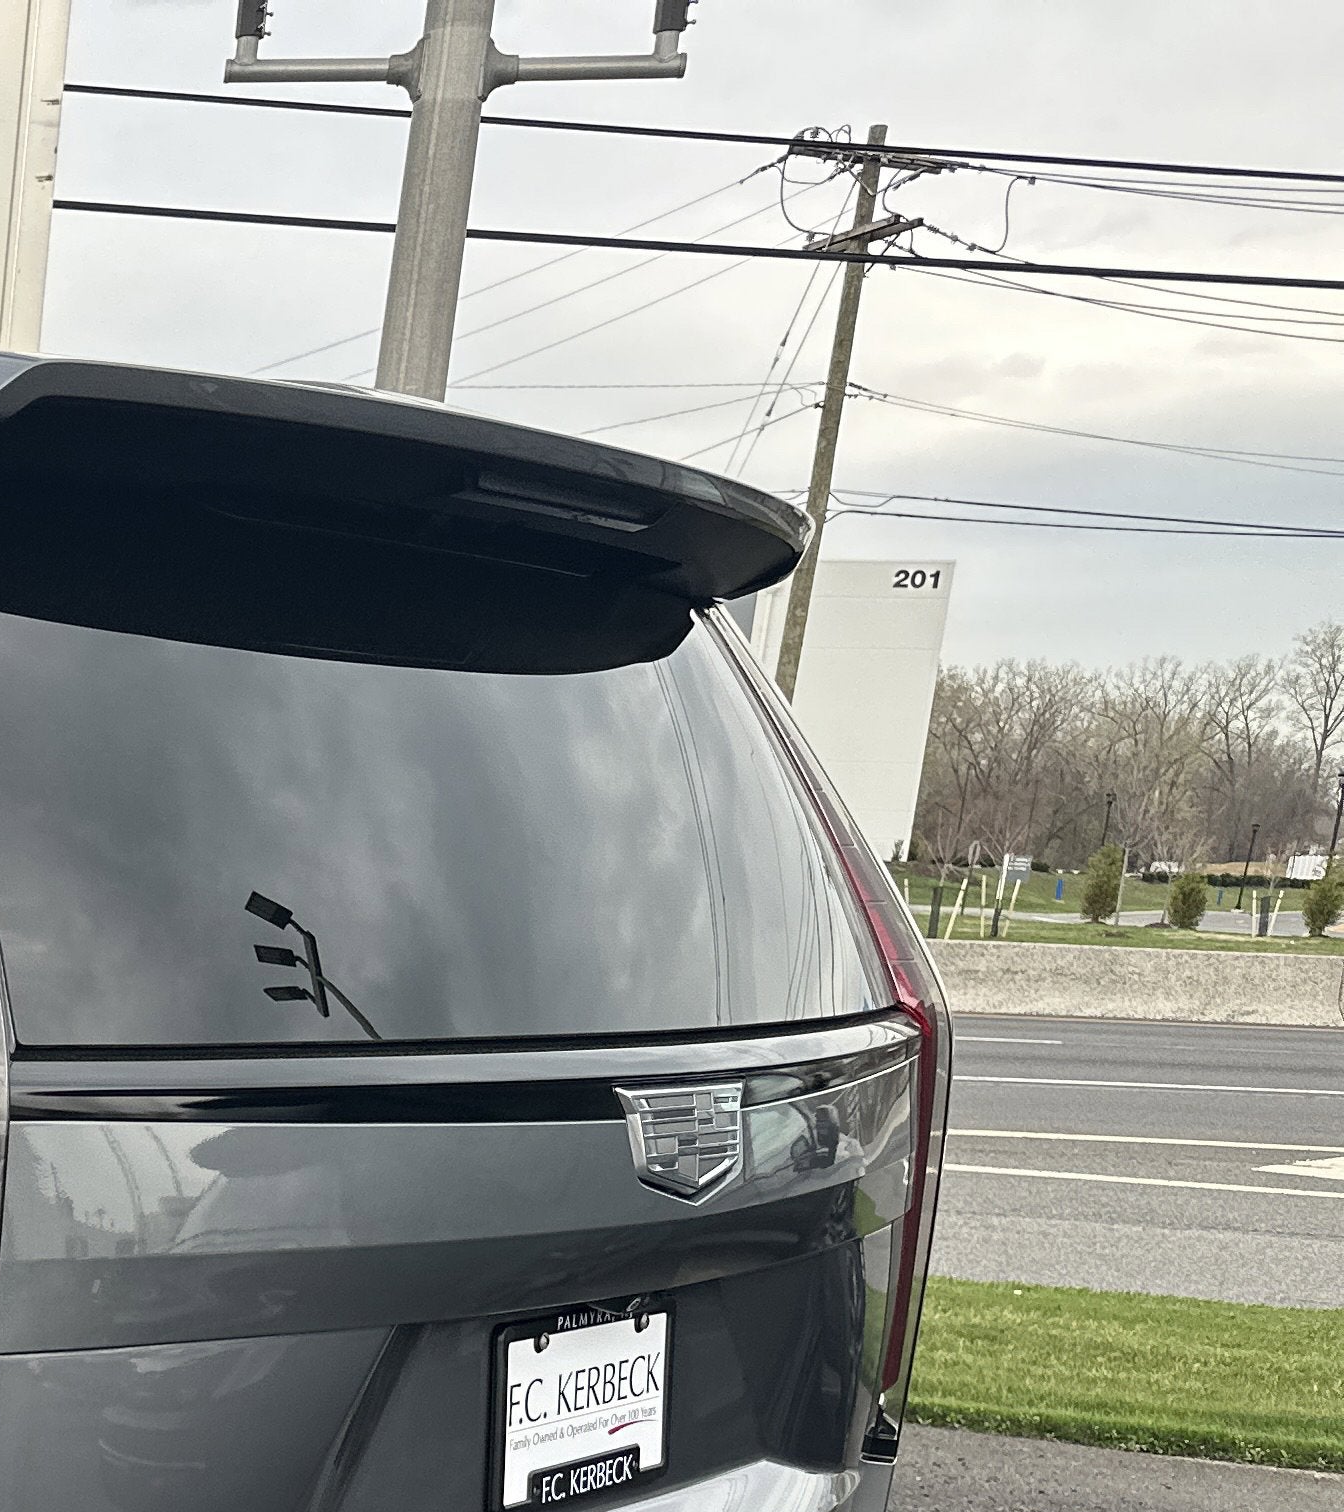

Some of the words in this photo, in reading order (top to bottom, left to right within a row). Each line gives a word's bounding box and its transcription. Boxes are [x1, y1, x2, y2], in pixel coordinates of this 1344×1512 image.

[892, 569, 941, 589] 201
[508, 1378, 547, 1427] F.C.
[557, 1352, 660, 1415] KERBECK
[509, 1434, 531, 1452] Family
[533, 1431, 557, 1446] Owned
[559, 1430, 565, 1439] &
[566, 1421, 598, 1438] Operated
[599, 1416, 609, 1428] For
[610, 1412, 627, 1426] Over
[628, 1409, 640, 1421] 100
[641, 1406, 656, 1419] Years
[541, 1473, 566, 1504] F.C.
[569, 1454, 634, 1496] KERBECK
